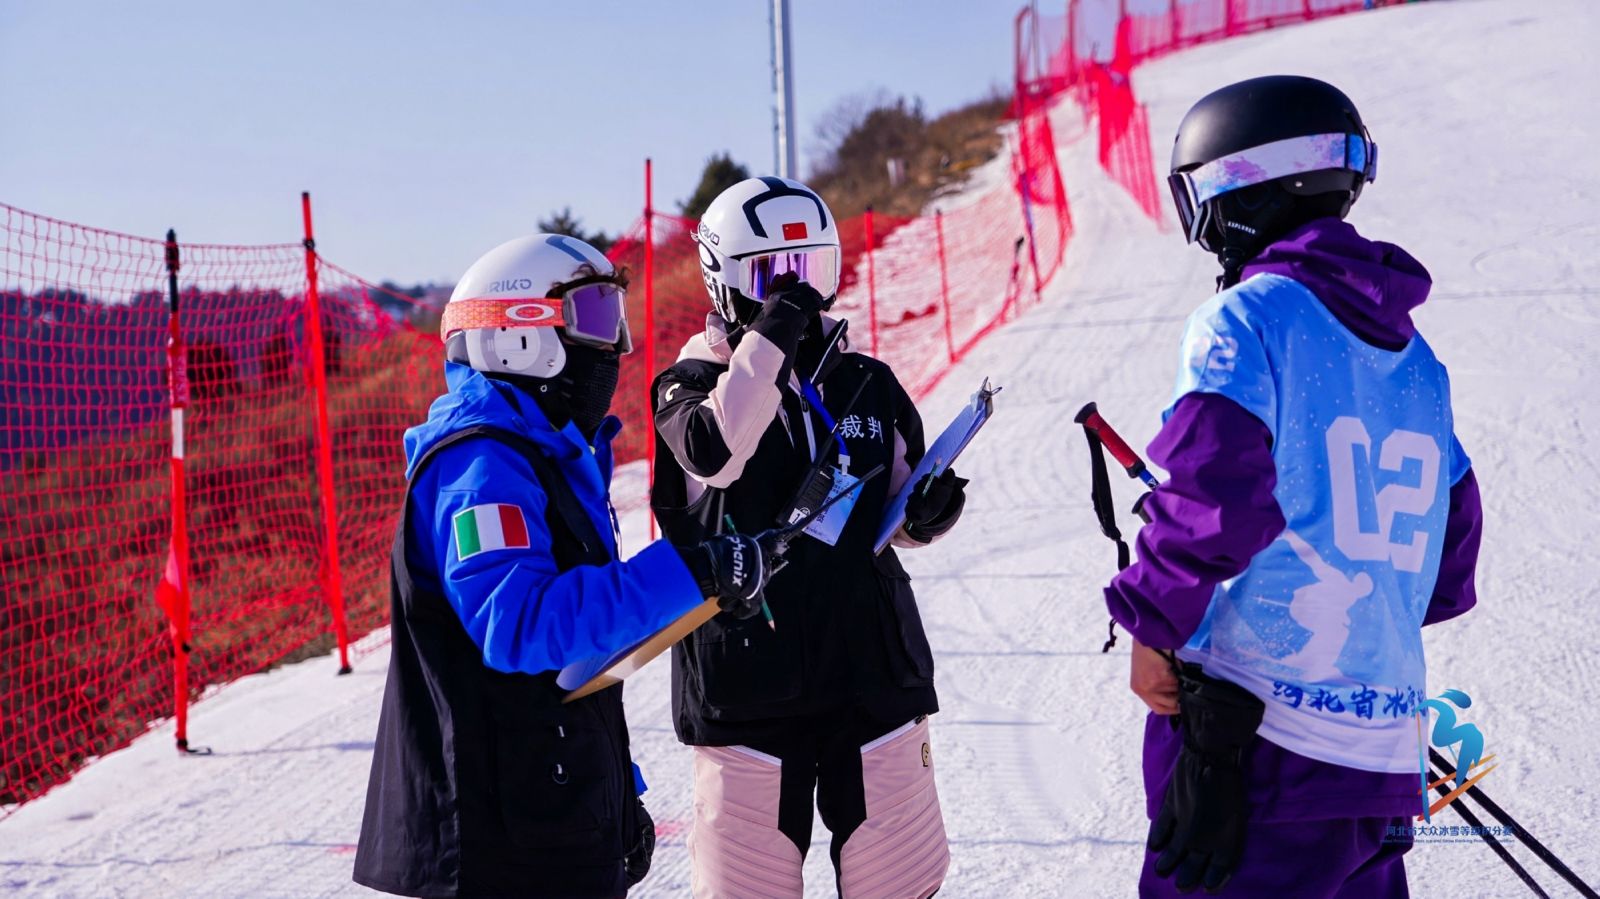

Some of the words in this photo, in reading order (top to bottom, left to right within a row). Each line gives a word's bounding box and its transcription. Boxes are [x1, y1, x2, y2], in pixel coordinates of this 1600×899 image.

[1227, 221, 1256, 235] EXPLORER
[485, 278, 533, 294] RIKO
[838, 414, 884, 445] 裁判
